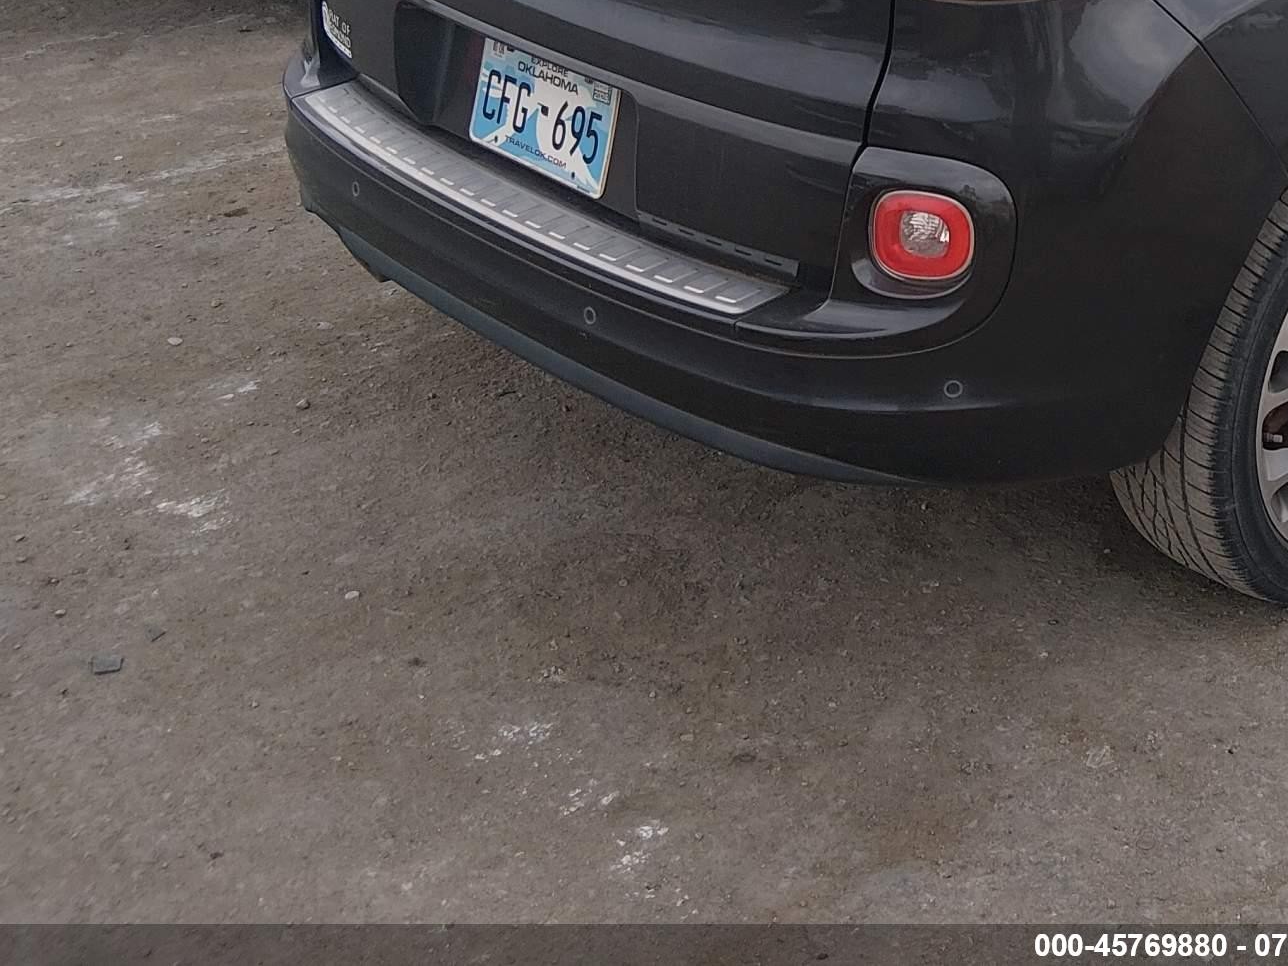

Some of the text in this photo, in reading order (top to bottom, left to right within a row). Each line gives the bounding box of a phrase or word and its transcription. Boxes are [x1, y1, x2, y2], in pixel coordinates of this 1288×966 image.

[517, 60, 579, 96] OKLAHOMA
[531, 56, 570, 78] EXPLORE
[505, 134, 567, 169] TRAVELOK.COM
